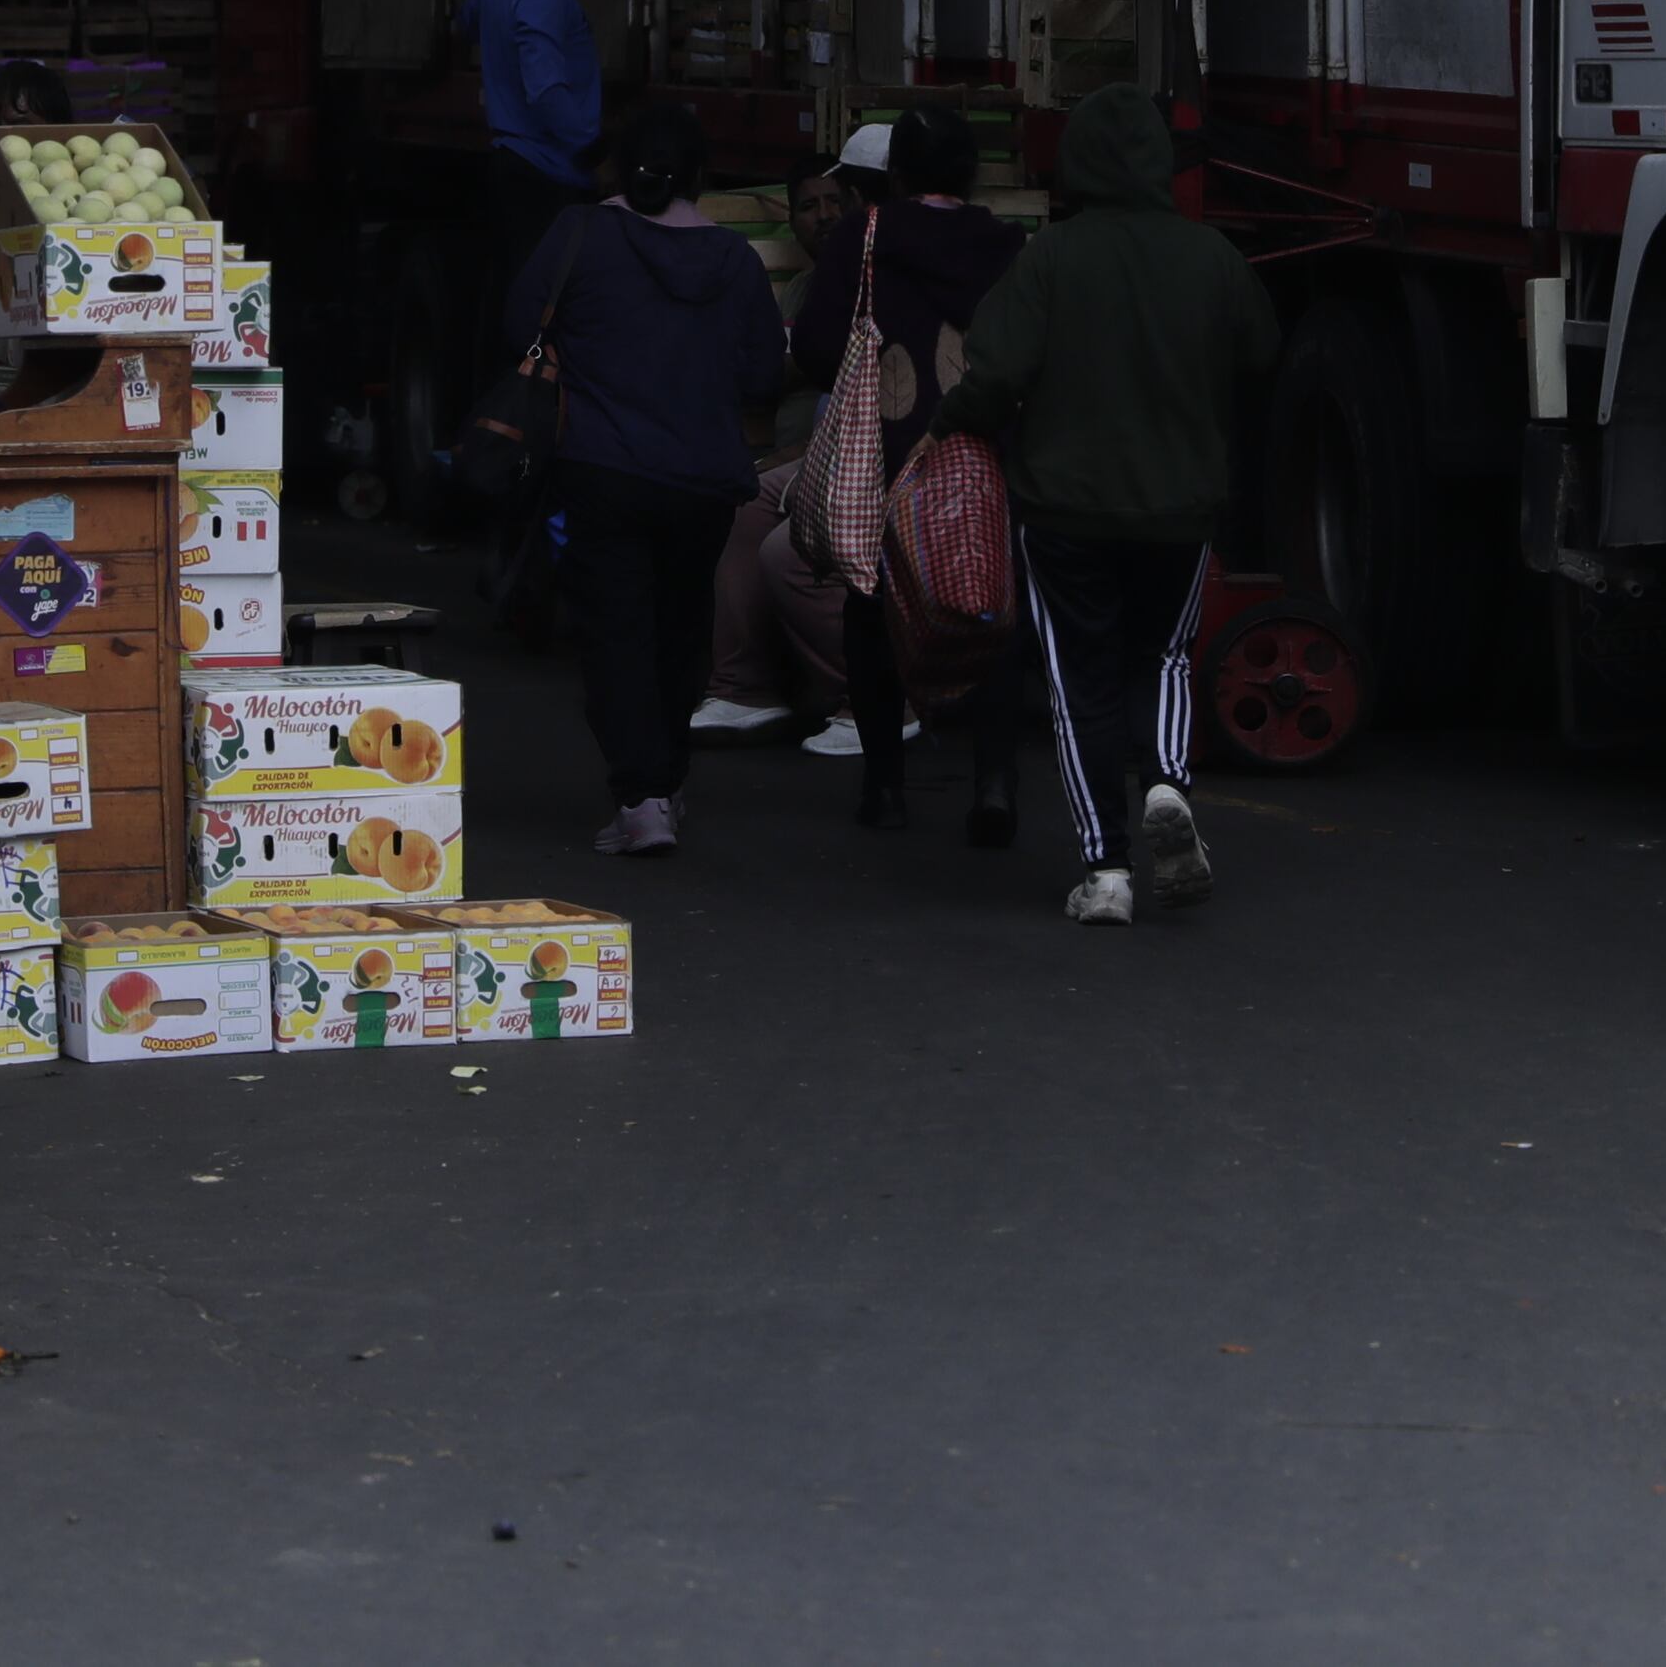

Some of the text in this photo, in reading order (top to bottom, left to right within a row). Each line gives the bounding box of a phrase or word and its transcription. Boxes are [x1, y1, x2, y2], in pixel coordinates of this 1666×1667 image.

[84, 294, 178, 325] Melocotón
[14, 555, 56, 570] PAGA
[22, 567, 62, 585] AQUÍ
[31, 599, 59, 621] yape
[245, 693, 365, 719] Melocotón
[276, 719, 329, 737] Huayco
[54, 784, 78, 792] Marca
[243, 801, 364, 827] Melocotón
[274, 827, 327, 844] Huayco
[141, 1032, 217, 1052] MELOCOTÓN
